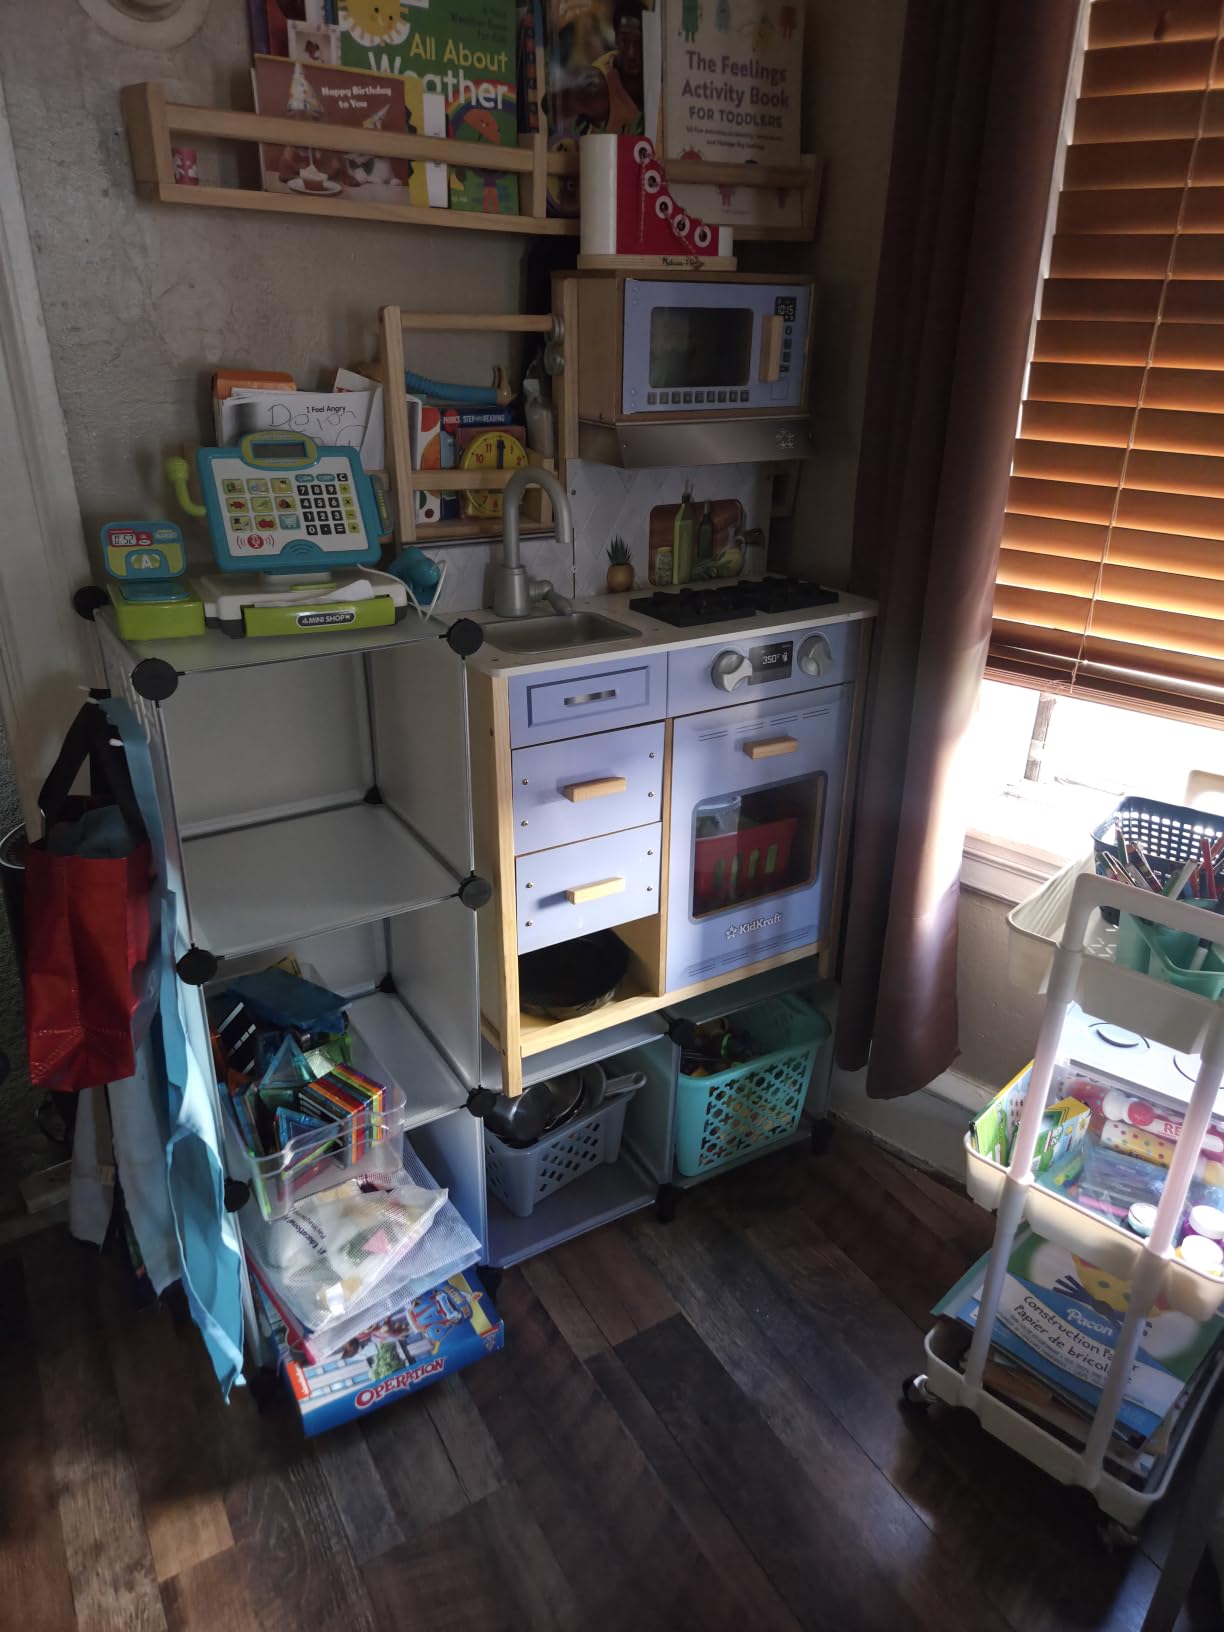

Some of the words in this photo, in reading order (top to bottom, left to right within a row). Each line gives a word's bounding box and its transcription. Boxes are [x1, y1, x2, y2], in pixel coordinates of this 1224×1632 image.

[409, 32, 436, 61] All
[443, 40, 508, 72] About
[685, 50, 717, 73] The
[721, 55, 788, 87] Feelings
[321, 85, 351, 98] Happy
[352, 83, 392, 97] Birthday
[339, 100, 349, 109] to
[349, 99, 367, 109] You
[681, 79, 745, 108] Activity
[749, 87, 790, 109] Book
[688, 106, 714, 121] FOR
[719, 109, 784, 129] TODDLERS
[306, 406, 310, 414] I
[311, 405, 325, 413] Feel
[326, 404, 347, 414] Angry
[325, 614, 345, 623] SHOP
[739, 911, 782, 935] KidKraft
[1013, 1304, 1049, 1334] Papier
[1048, 1335, 1065, 1349] de
[1023, 1295, 1100, 1354] Construction
[1066, 1307, 1113, 1336] Pacon
[355, 1356, 447, 1409] OPERATION
